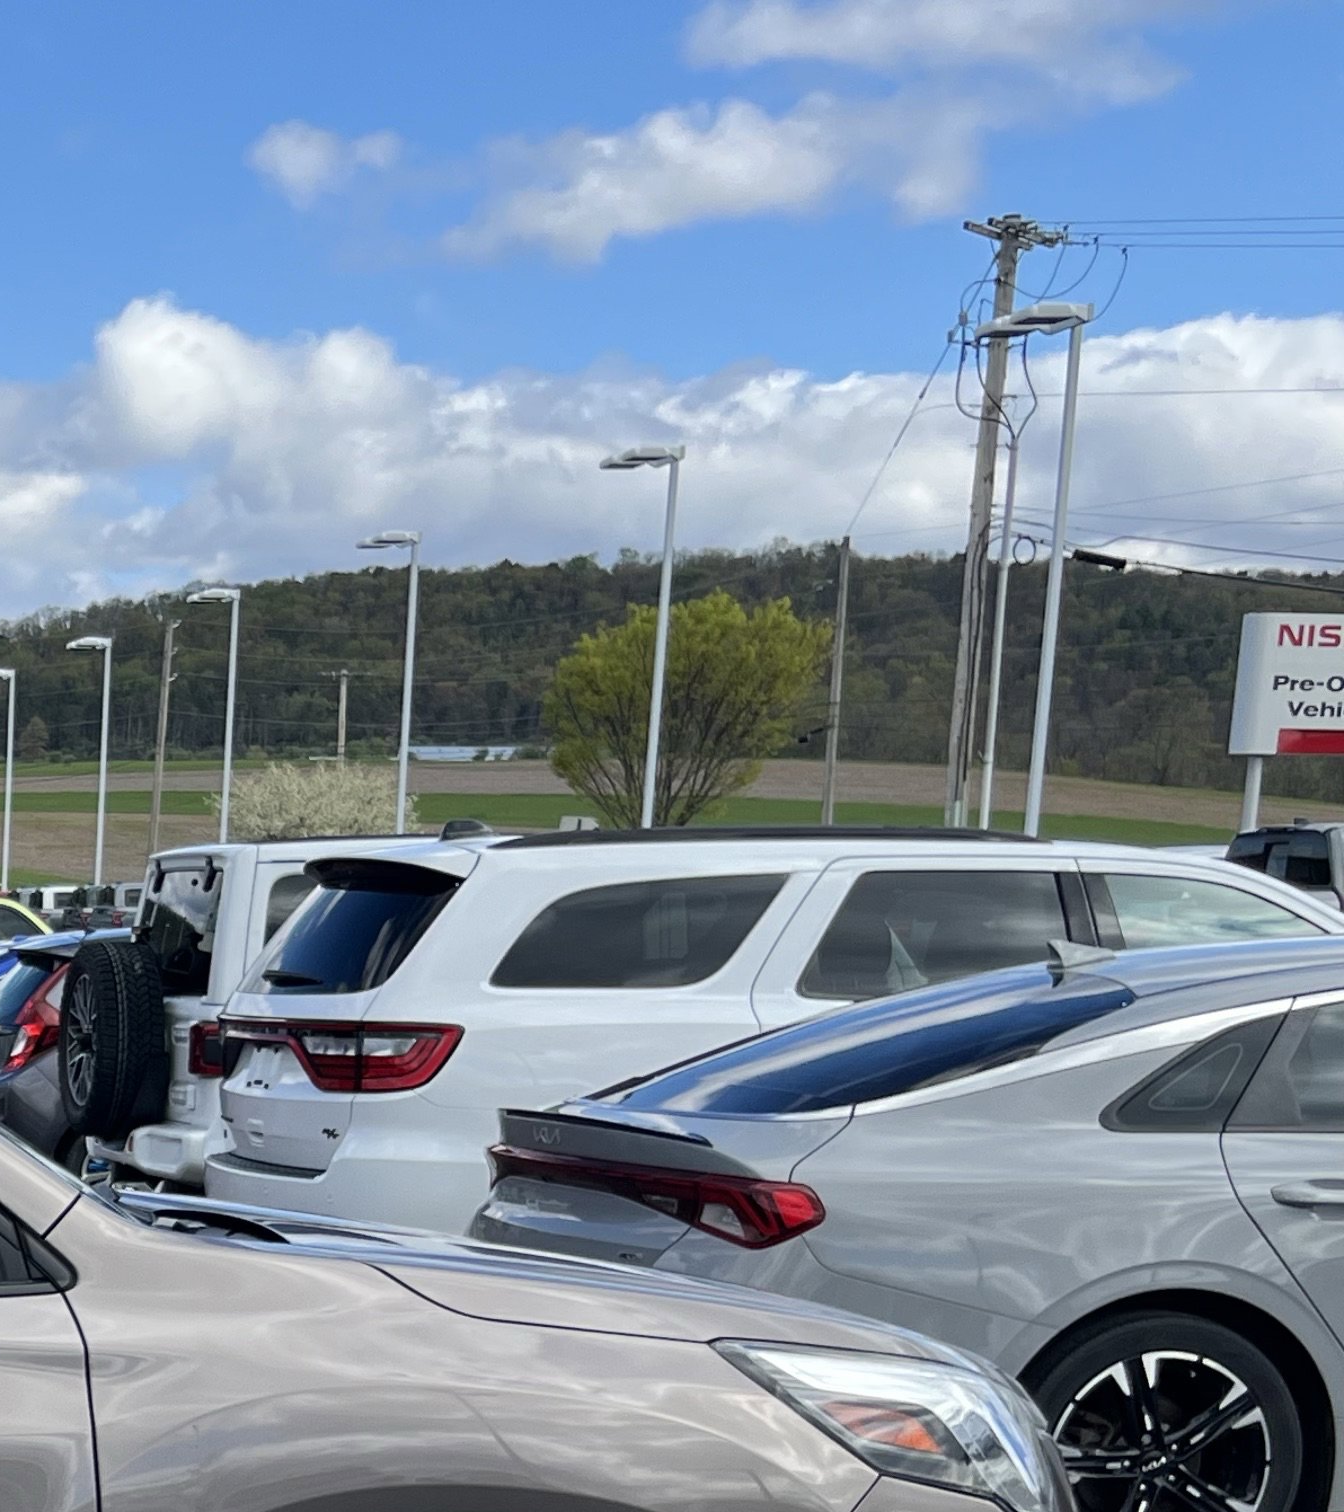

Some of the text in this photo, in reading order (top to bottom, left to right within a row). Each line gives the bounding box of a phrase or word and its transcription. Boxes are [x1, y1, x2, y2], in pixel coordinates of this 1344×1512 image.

[1277, 624, 1341, 647] NIS
[1272, 675, 1344, 692] Pre-O
[1287, 701, 1343, 717] Vehi
